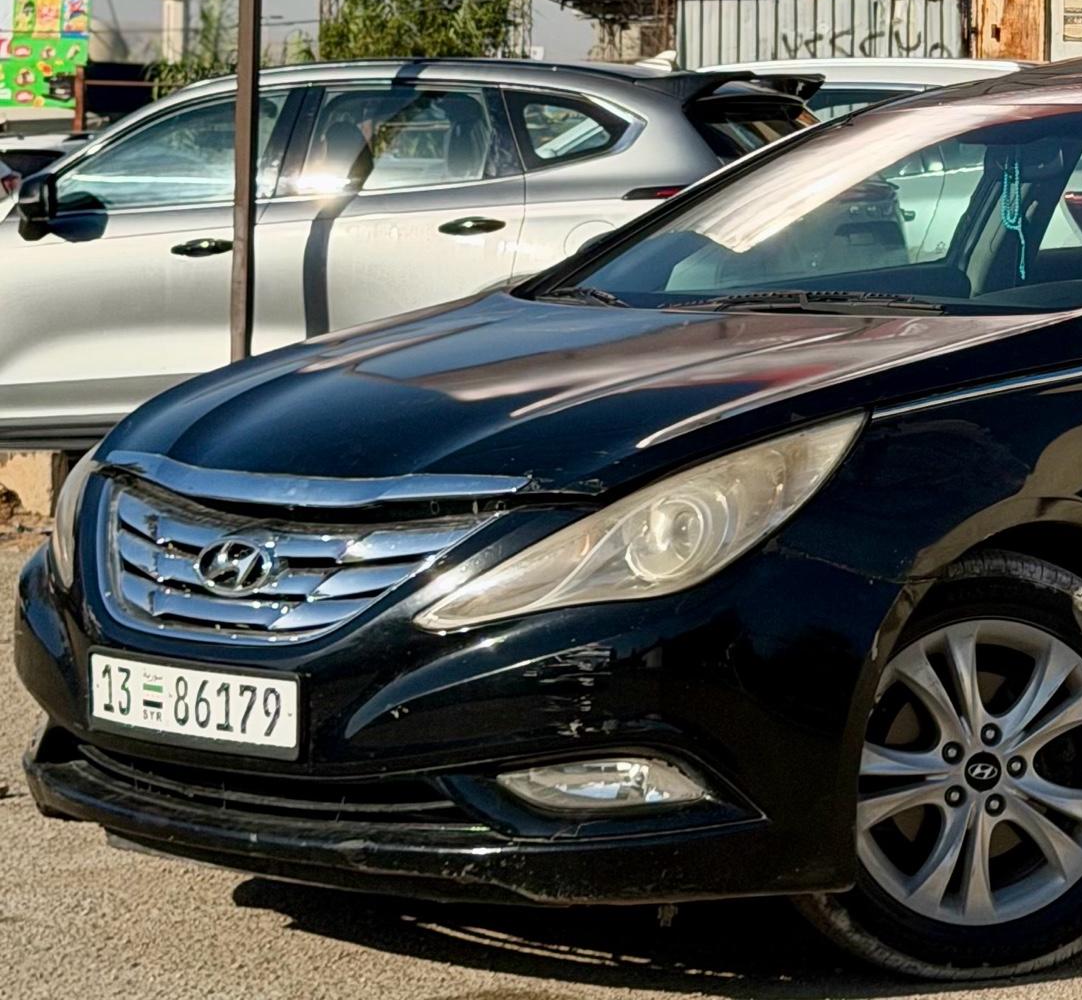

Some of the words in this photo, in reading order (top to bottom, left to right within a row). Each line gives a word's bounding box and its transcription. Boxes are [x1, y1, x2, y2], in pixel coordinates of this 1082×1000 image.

[102, 664, 131, 716] 13
[174, 676, 281, 737] 86179
[143, 709, 162, 721] SYR
